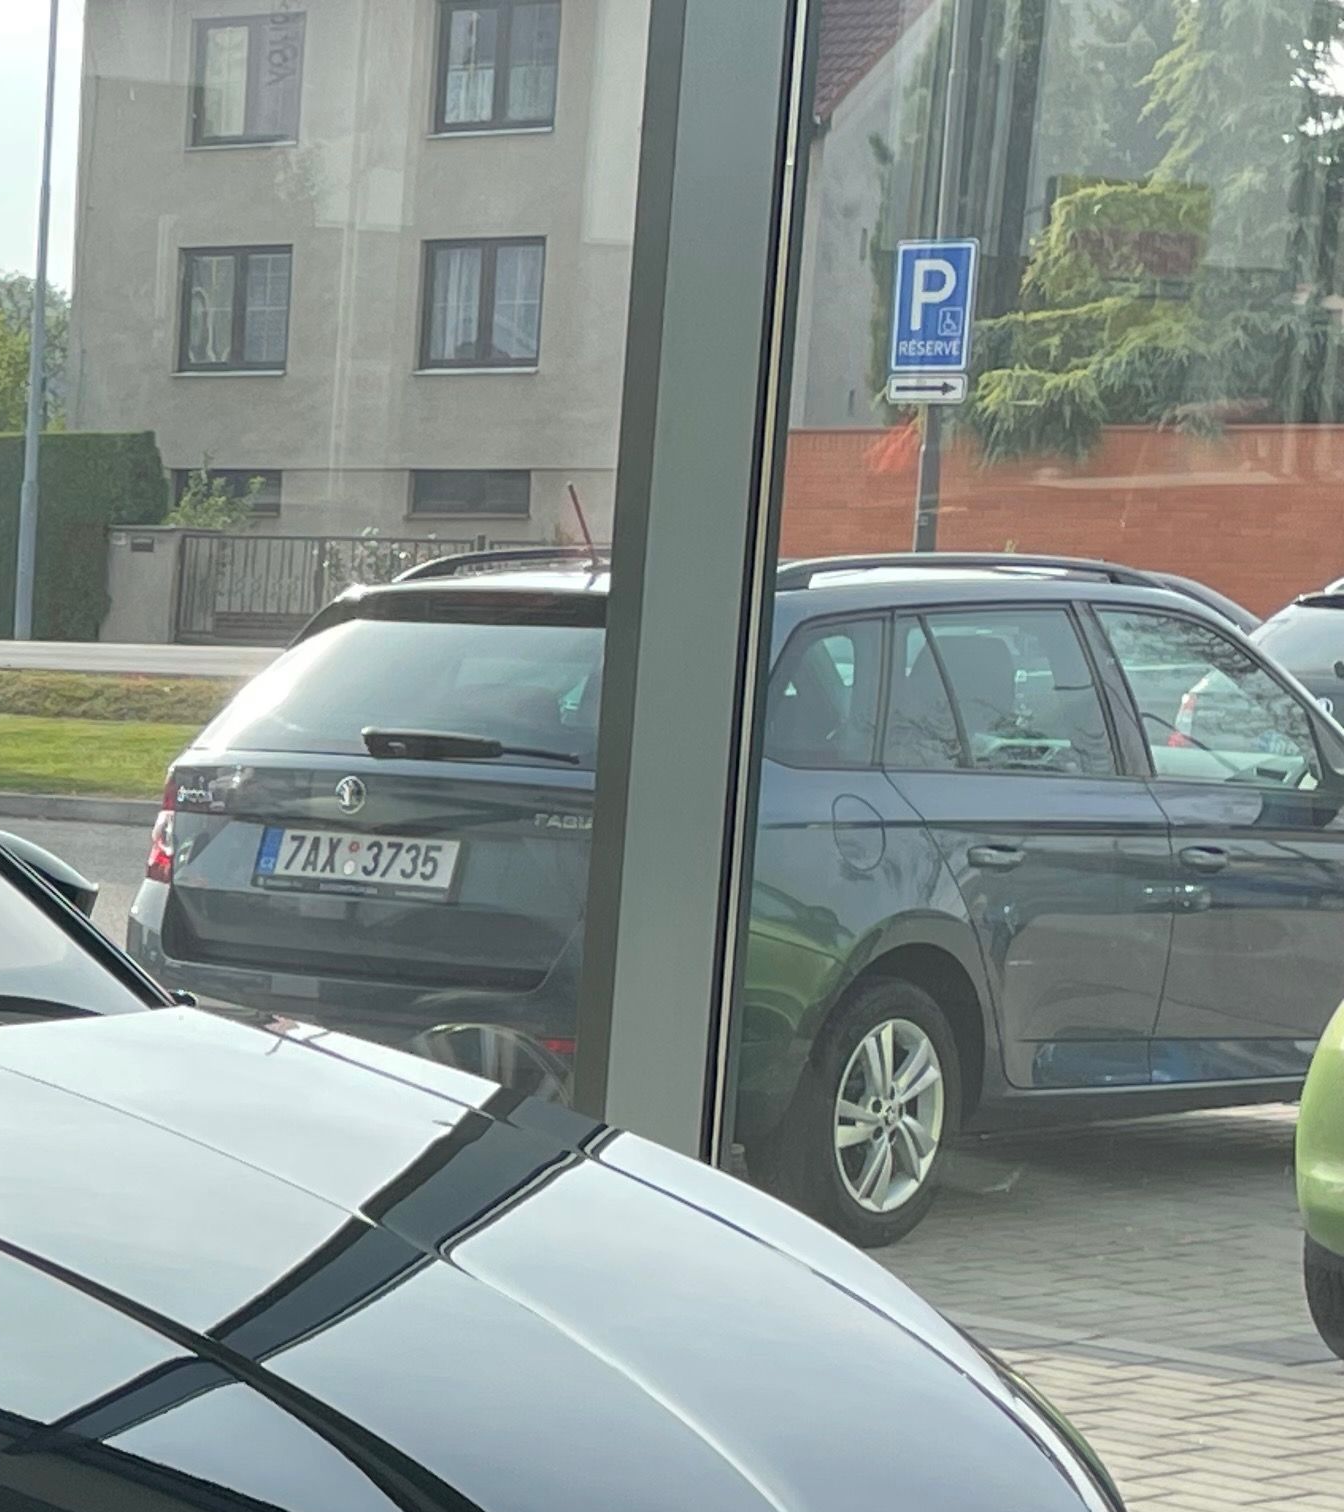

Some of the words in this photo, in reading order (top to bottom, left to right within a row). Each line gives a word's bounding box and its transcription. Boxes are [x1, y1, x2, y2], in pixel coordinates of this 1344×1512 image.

[910, 258, 957, 331] P
[284, 835, 342, 873] 7AX
[362, 840, 442, 881] 3735
